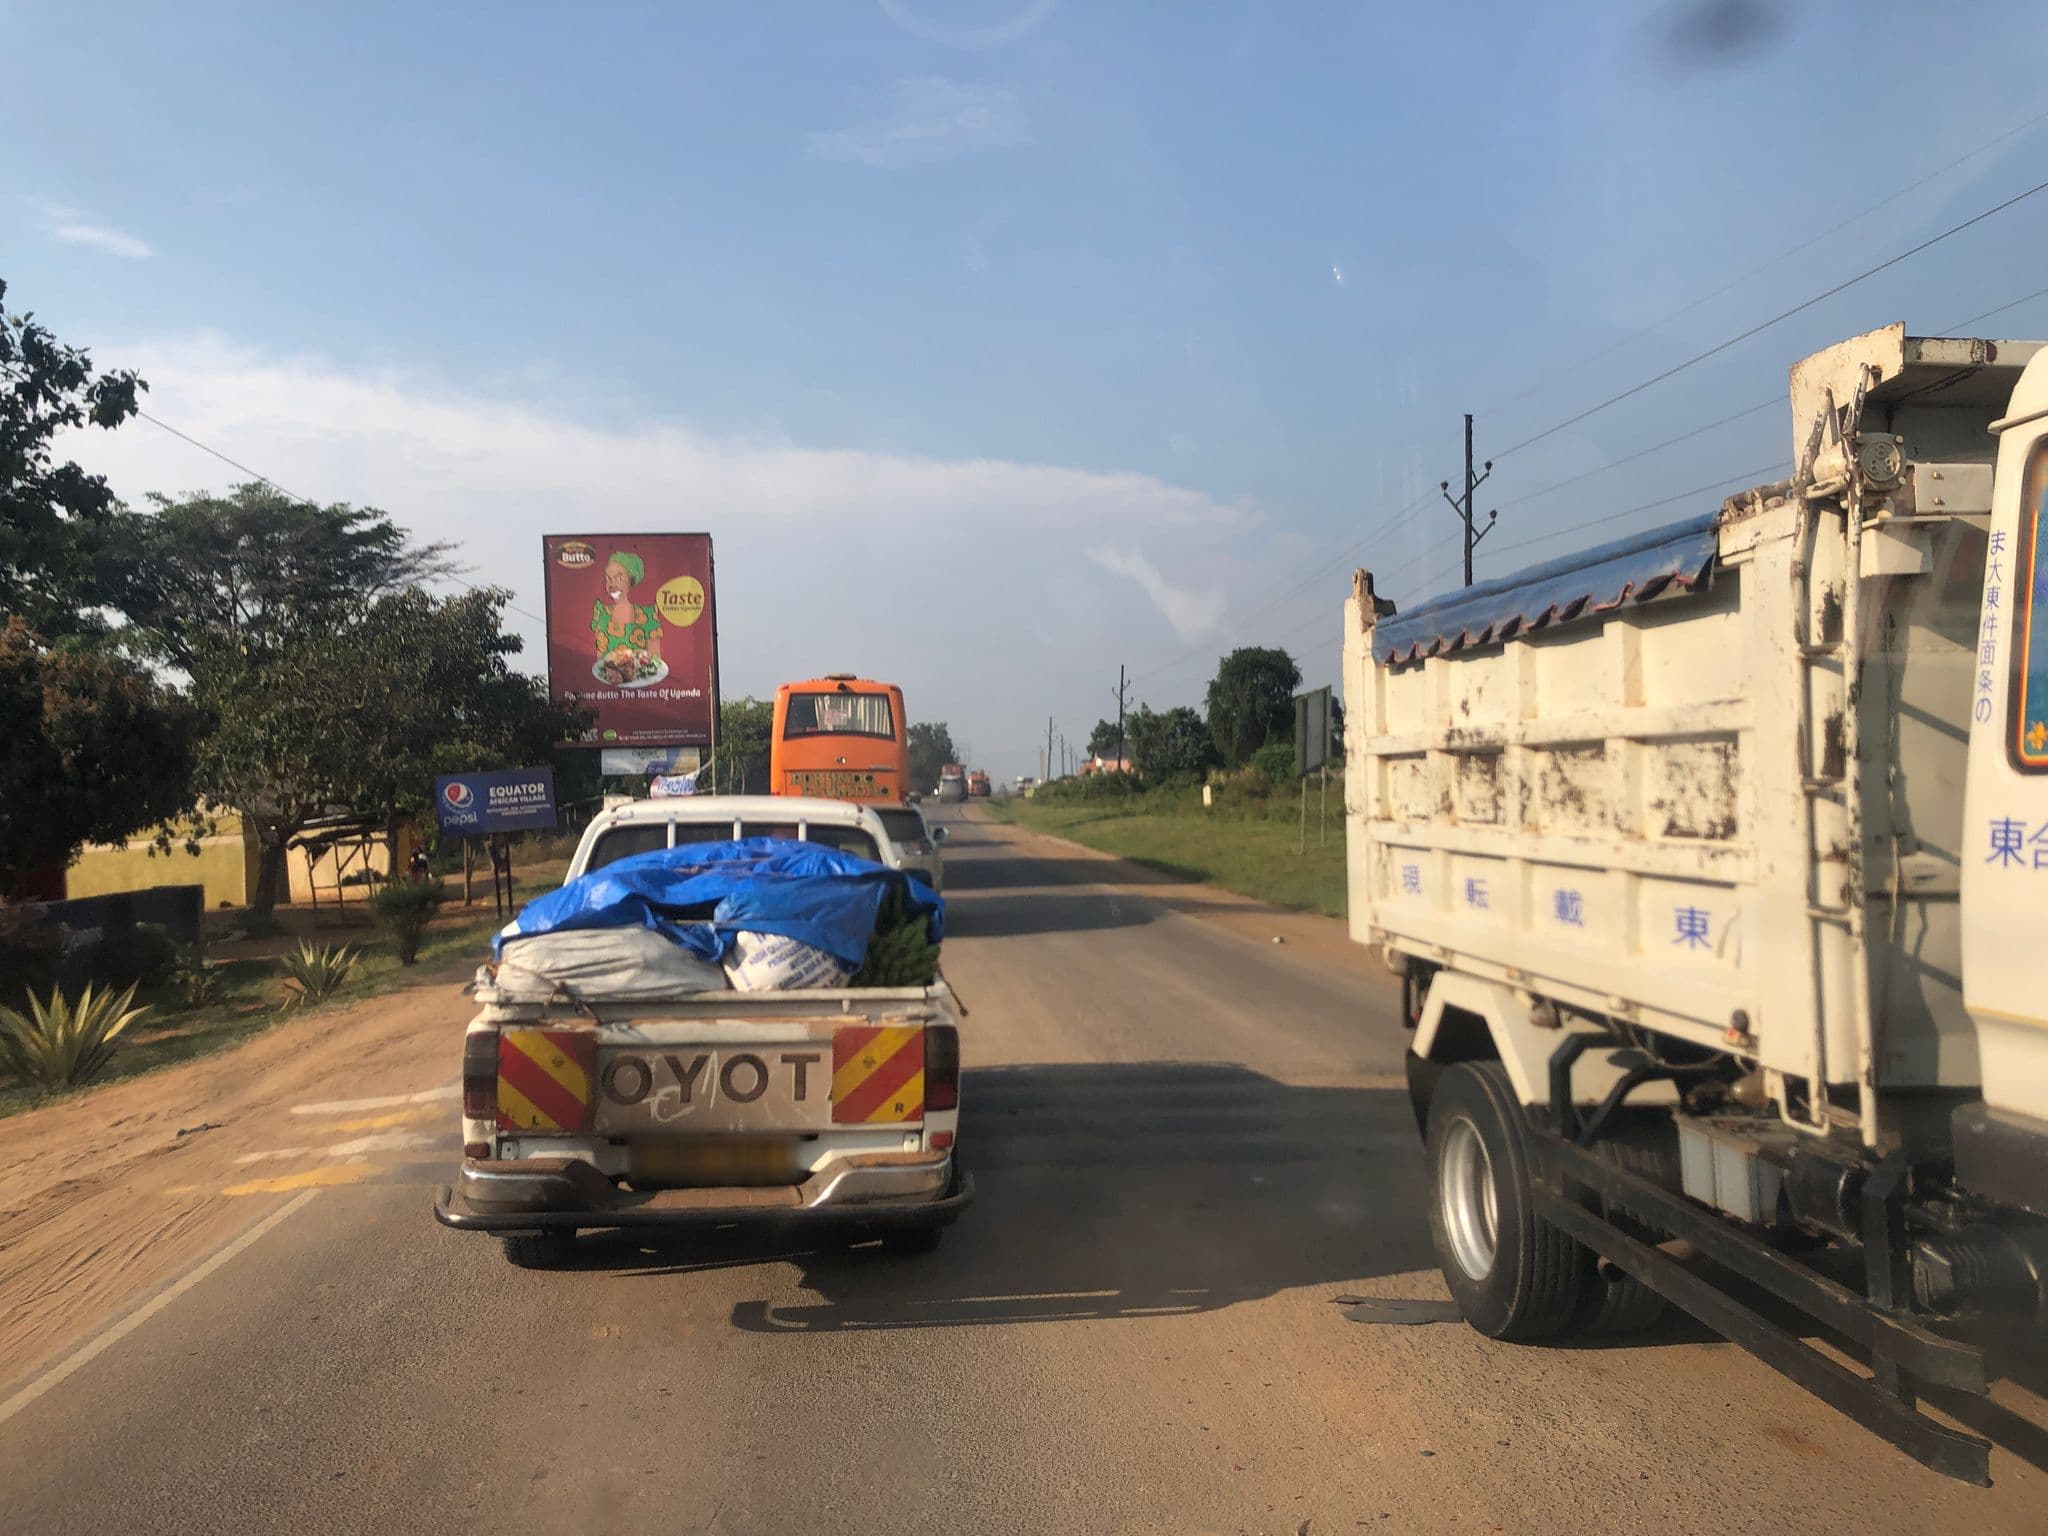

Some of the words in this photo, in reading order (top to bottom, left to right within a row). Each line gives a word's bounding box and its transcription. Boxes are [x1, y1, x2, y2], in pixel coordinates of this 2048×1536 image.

[661, 590, 702, 605] Taste
[621, 690, 635, 699] The
[637, 689, 658, 698] Taste
[670, 688, 701, 699] Uganda
[489, 783, 545, 798] EQUATOR
[489, 797, 518, 806] AFRICAN
[520, 794, 546, 802] VILLAGE
[444, 812, 477, 827] pepsi
[601, 1053, 833, 1103] OYOT
